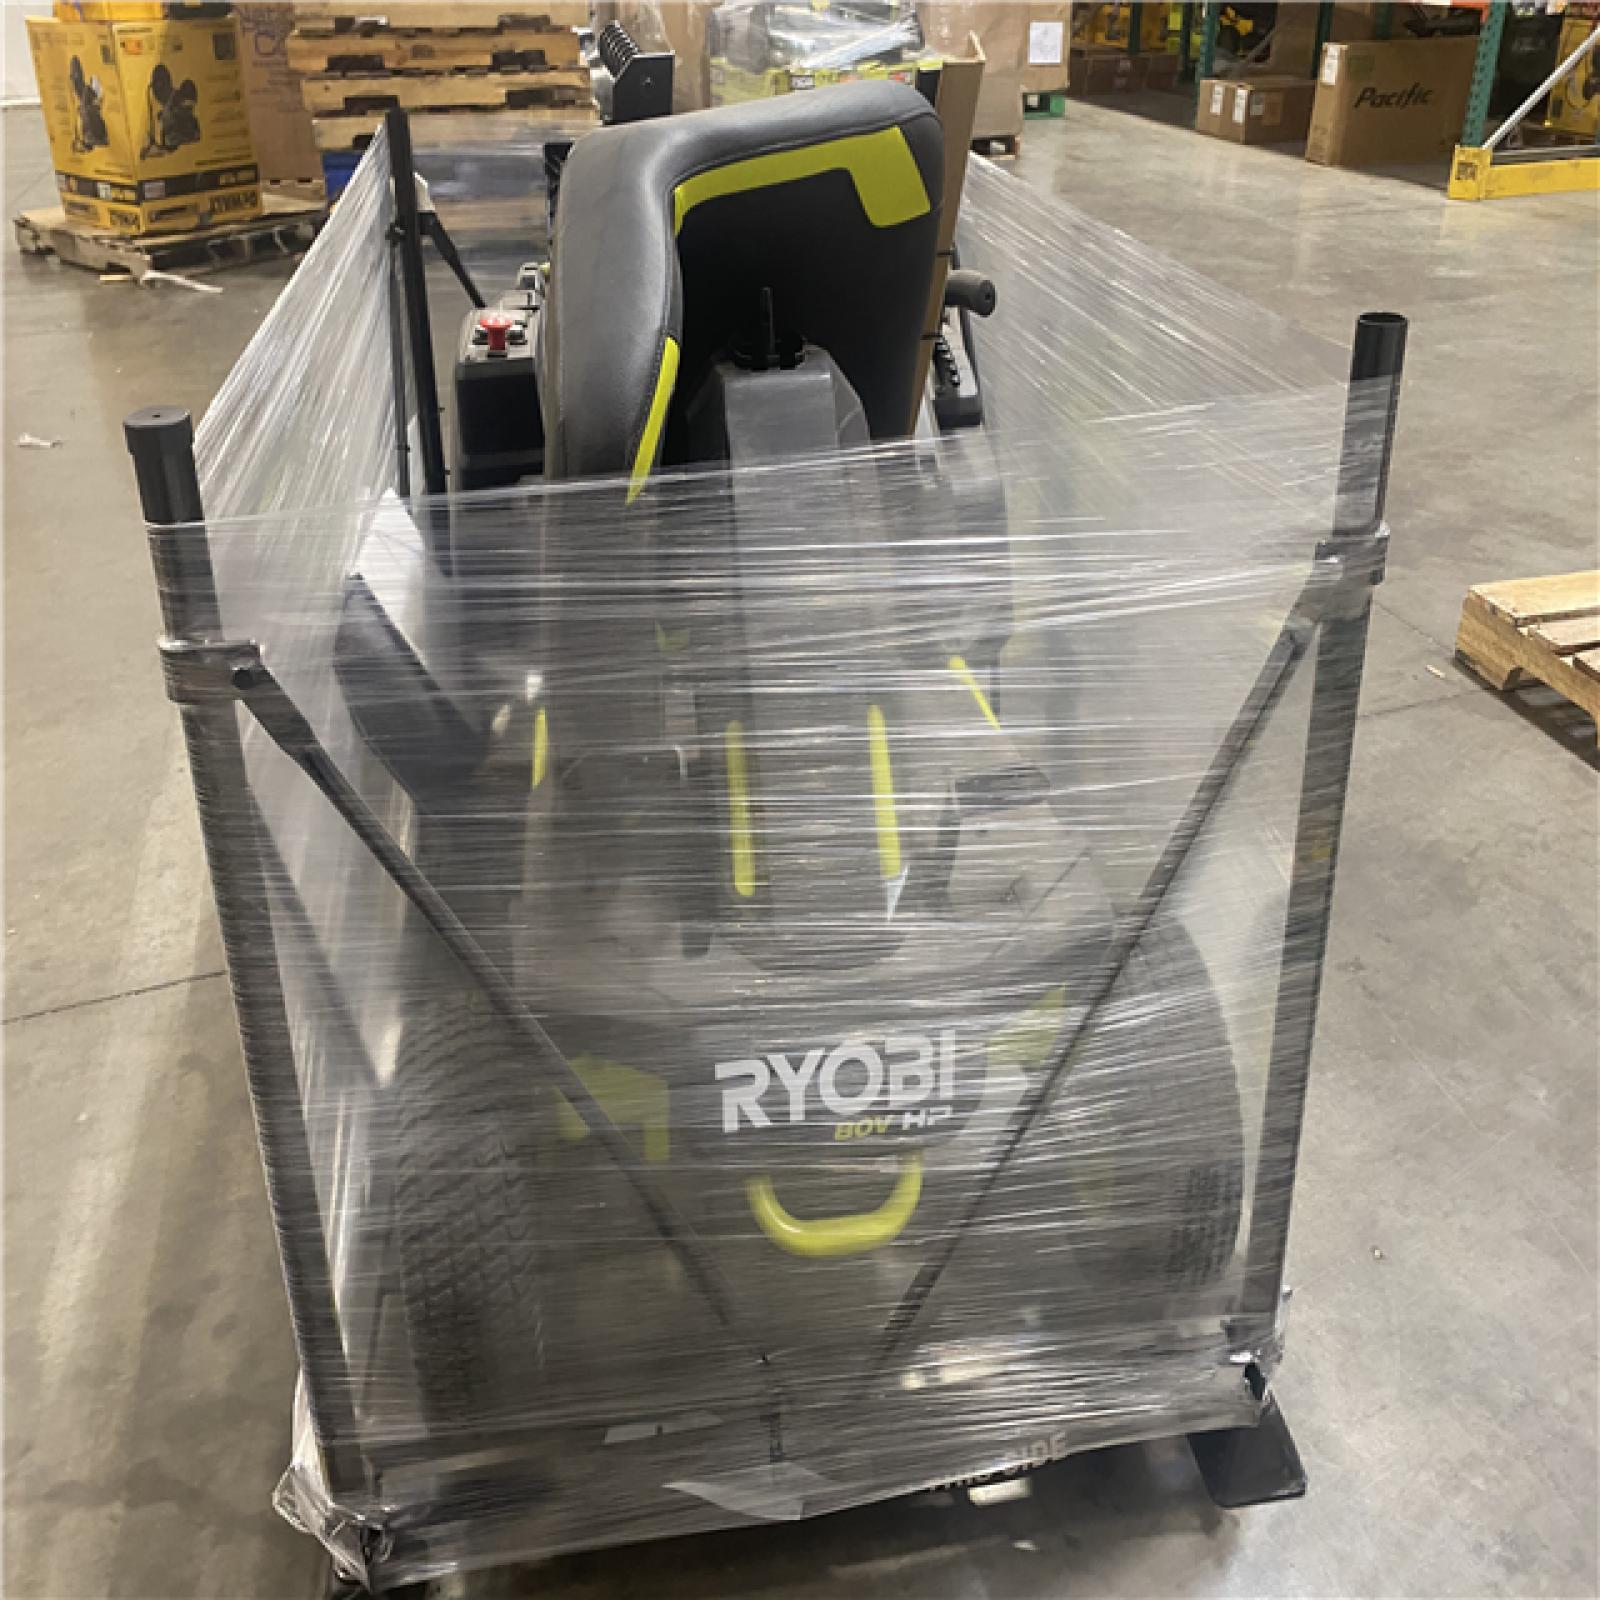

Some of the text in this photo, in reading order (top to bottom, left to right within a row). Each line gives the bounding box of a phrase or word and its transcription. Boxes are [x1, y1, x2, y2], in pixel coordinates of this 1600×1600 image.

[1353, 82, 1433, 108] Pacific
[714, 1030, 956, 1134] RYOBI
[902, 1106, 953, 1131] HP
